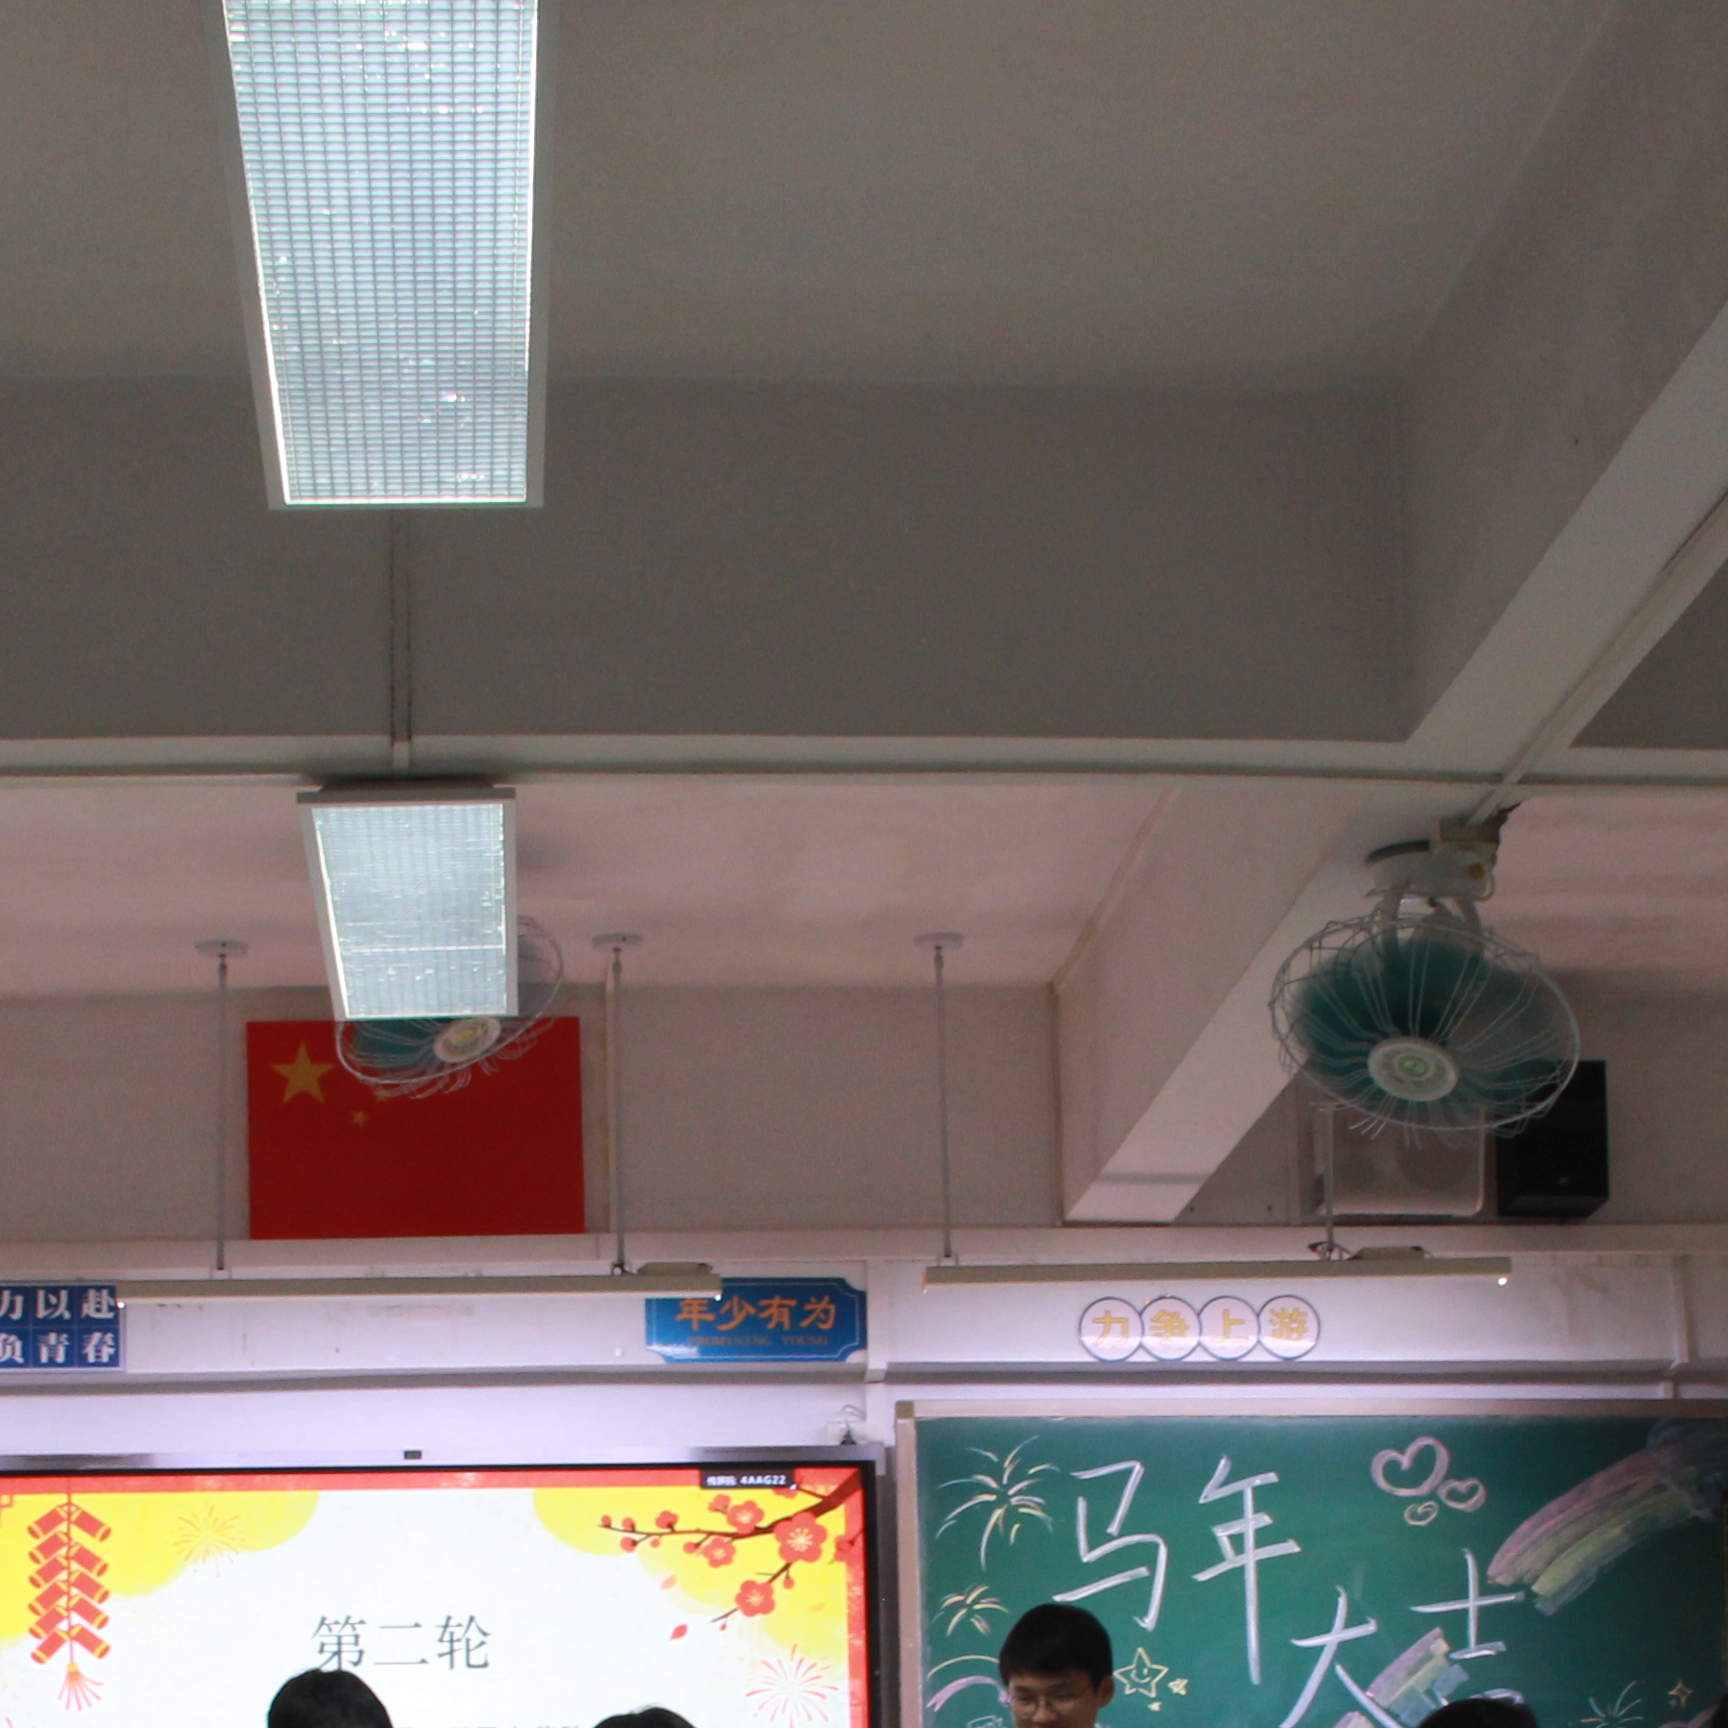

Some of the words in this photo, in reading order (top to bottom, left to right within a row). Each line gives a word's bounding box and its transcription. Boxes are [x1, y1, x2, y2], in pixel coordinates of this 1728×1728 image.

[675, 1295, 837, 1332] 年少有为
[1092, 1308, 1309, 1347] 力争上游
[1053, 1454, 1302, 1685] 马年
[311, 1614, 492, 1672] 第二轮
